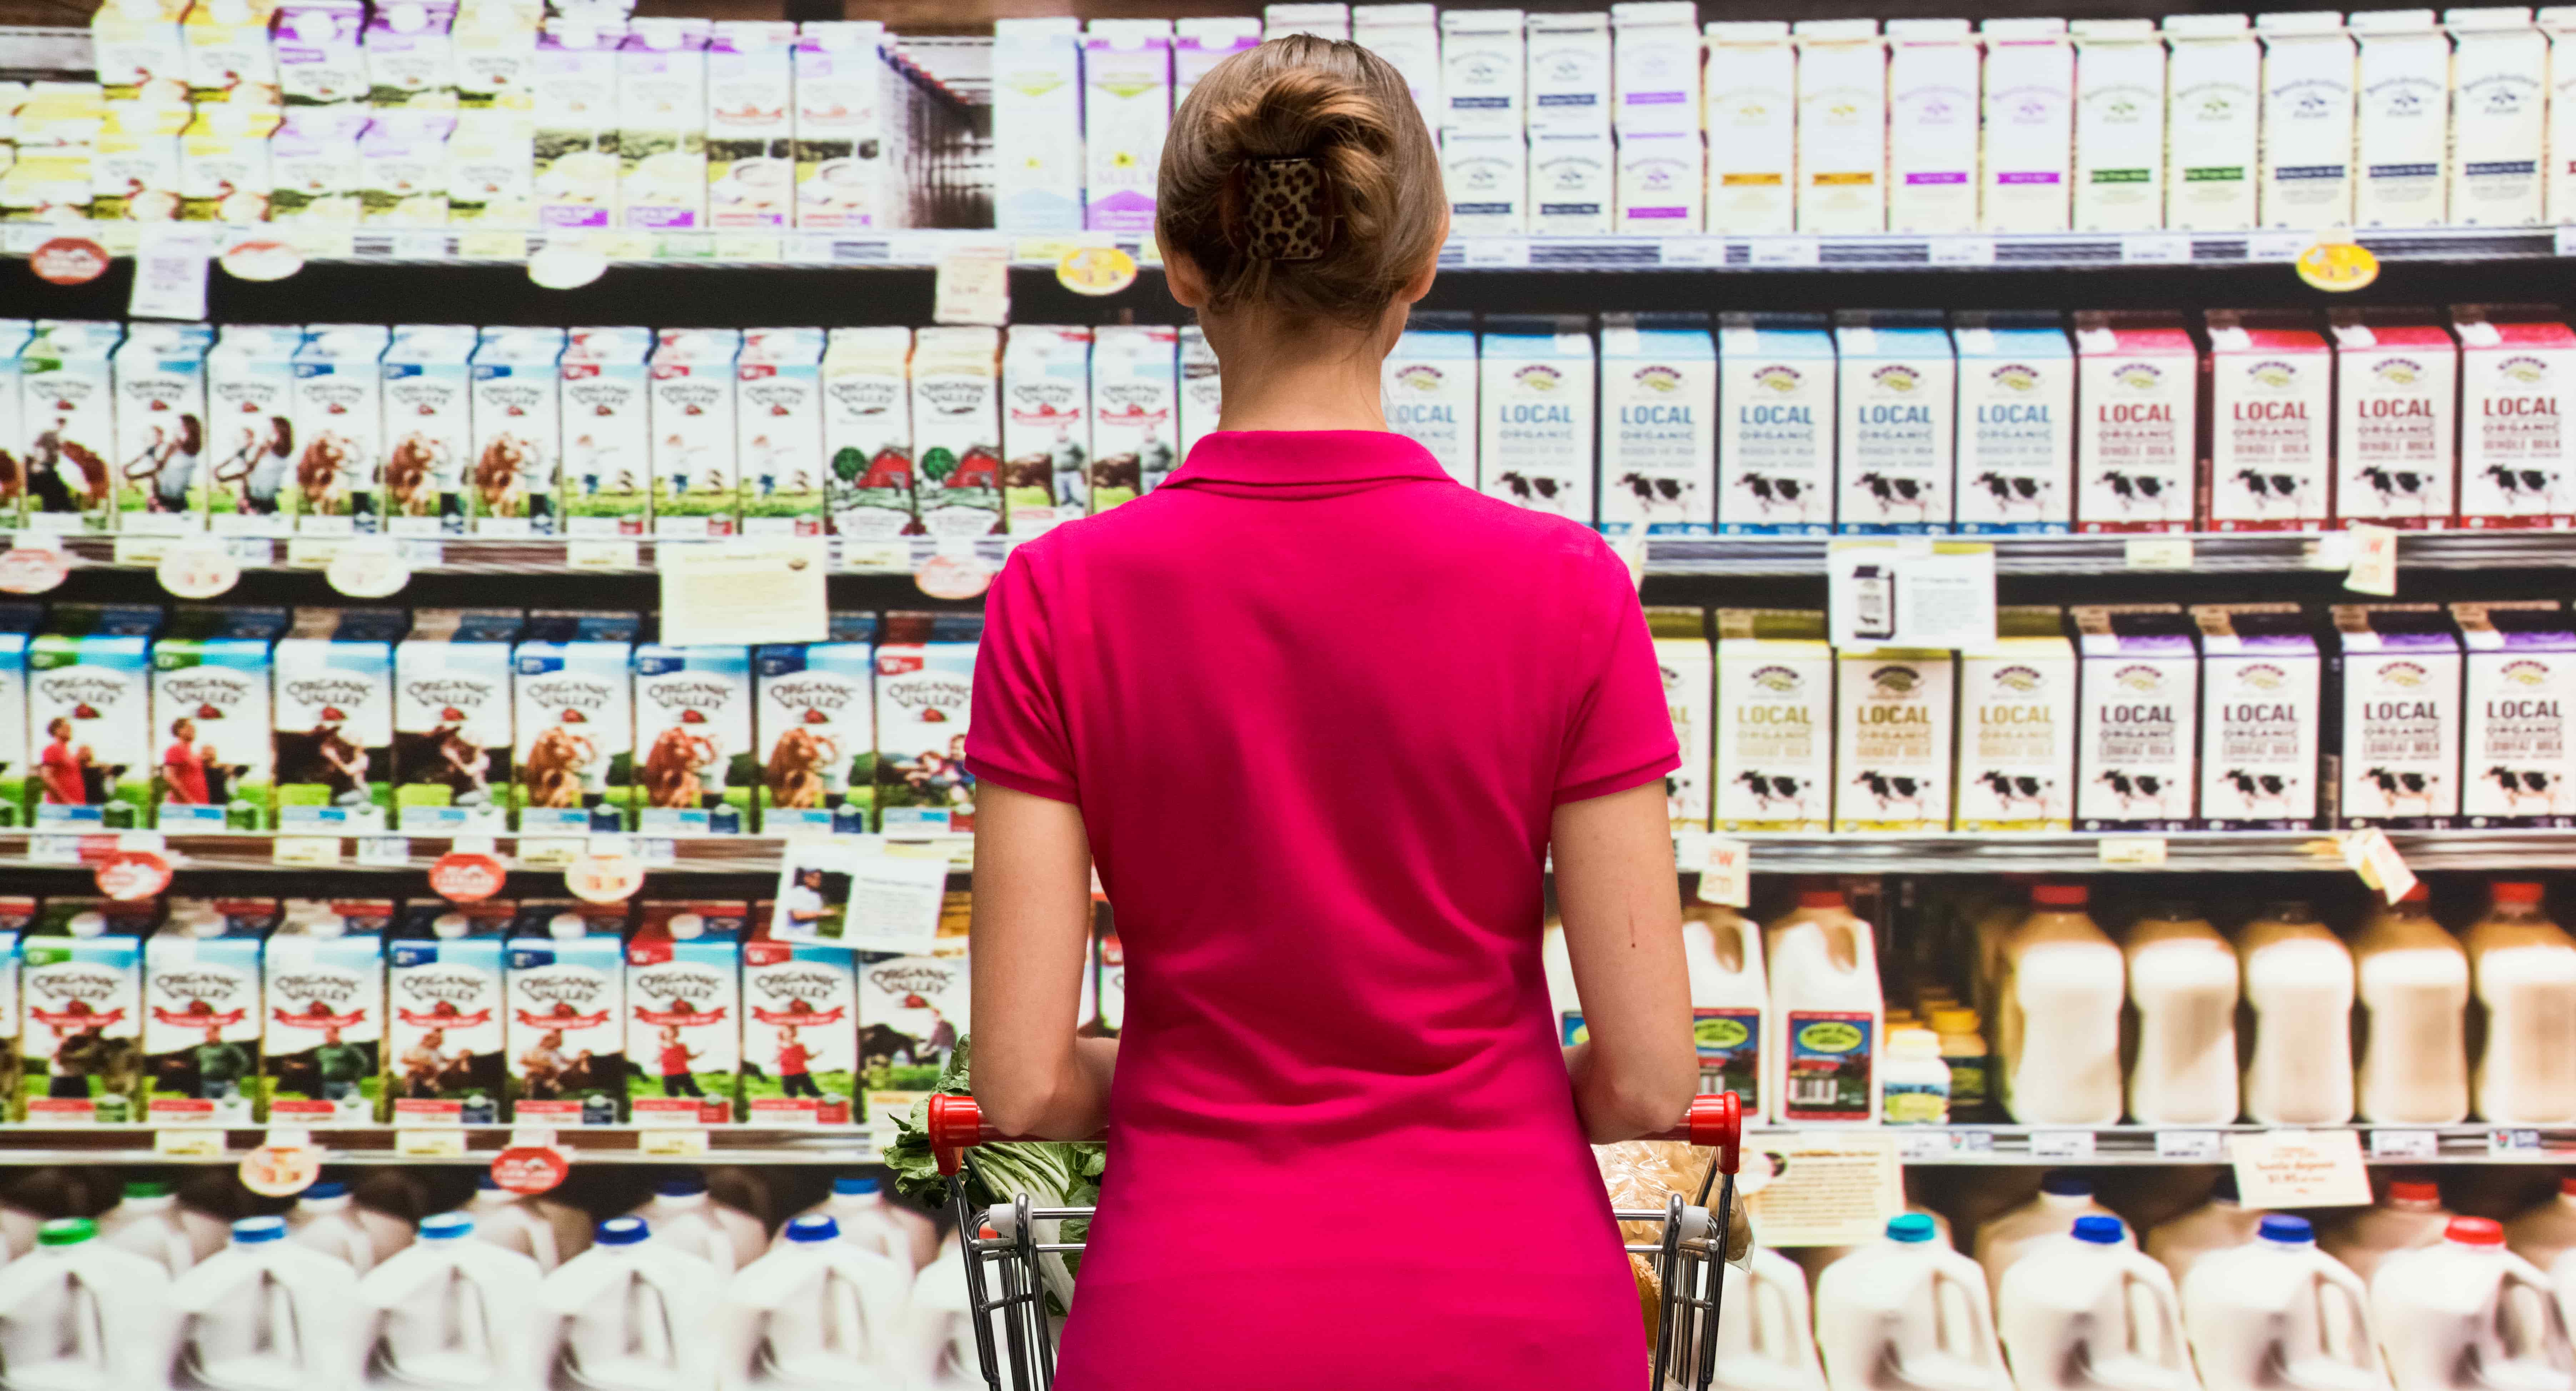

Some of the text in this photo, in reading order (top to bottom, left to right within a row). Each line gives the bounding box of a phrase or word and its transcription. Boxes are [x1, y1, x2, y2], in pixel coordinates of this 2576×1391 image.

[1501, 405, 1573, 424] LOCAL
[1621, 406, 1693, 425] LOCAL
[1741, 406, 1813, 425] LOCAL
[1859, 406, 1932, 424] LOCAL
[1978, 405, 2051, 424] LOCAL
[2099, 404, 2173, 423] LOCAL
[2234, 402, 2309, 421] LOCAL
[2359, 398, 2434, 418] LOCAL
[2484, 397, 2559, 417] LOCAL
[1738, 706, 1812, 724] LOCAL
[1857, 705, 1931, 724] LOCAL
[1979, 705, 2053, 724] LOCAL
[2101, 705, 2175, 723] LOCAL
[2224, 704, 2298, 723] LOCAL
[2364, 702, 2440, 720] LOCAL
[2487, 701, 2562, 719] LOCAL
